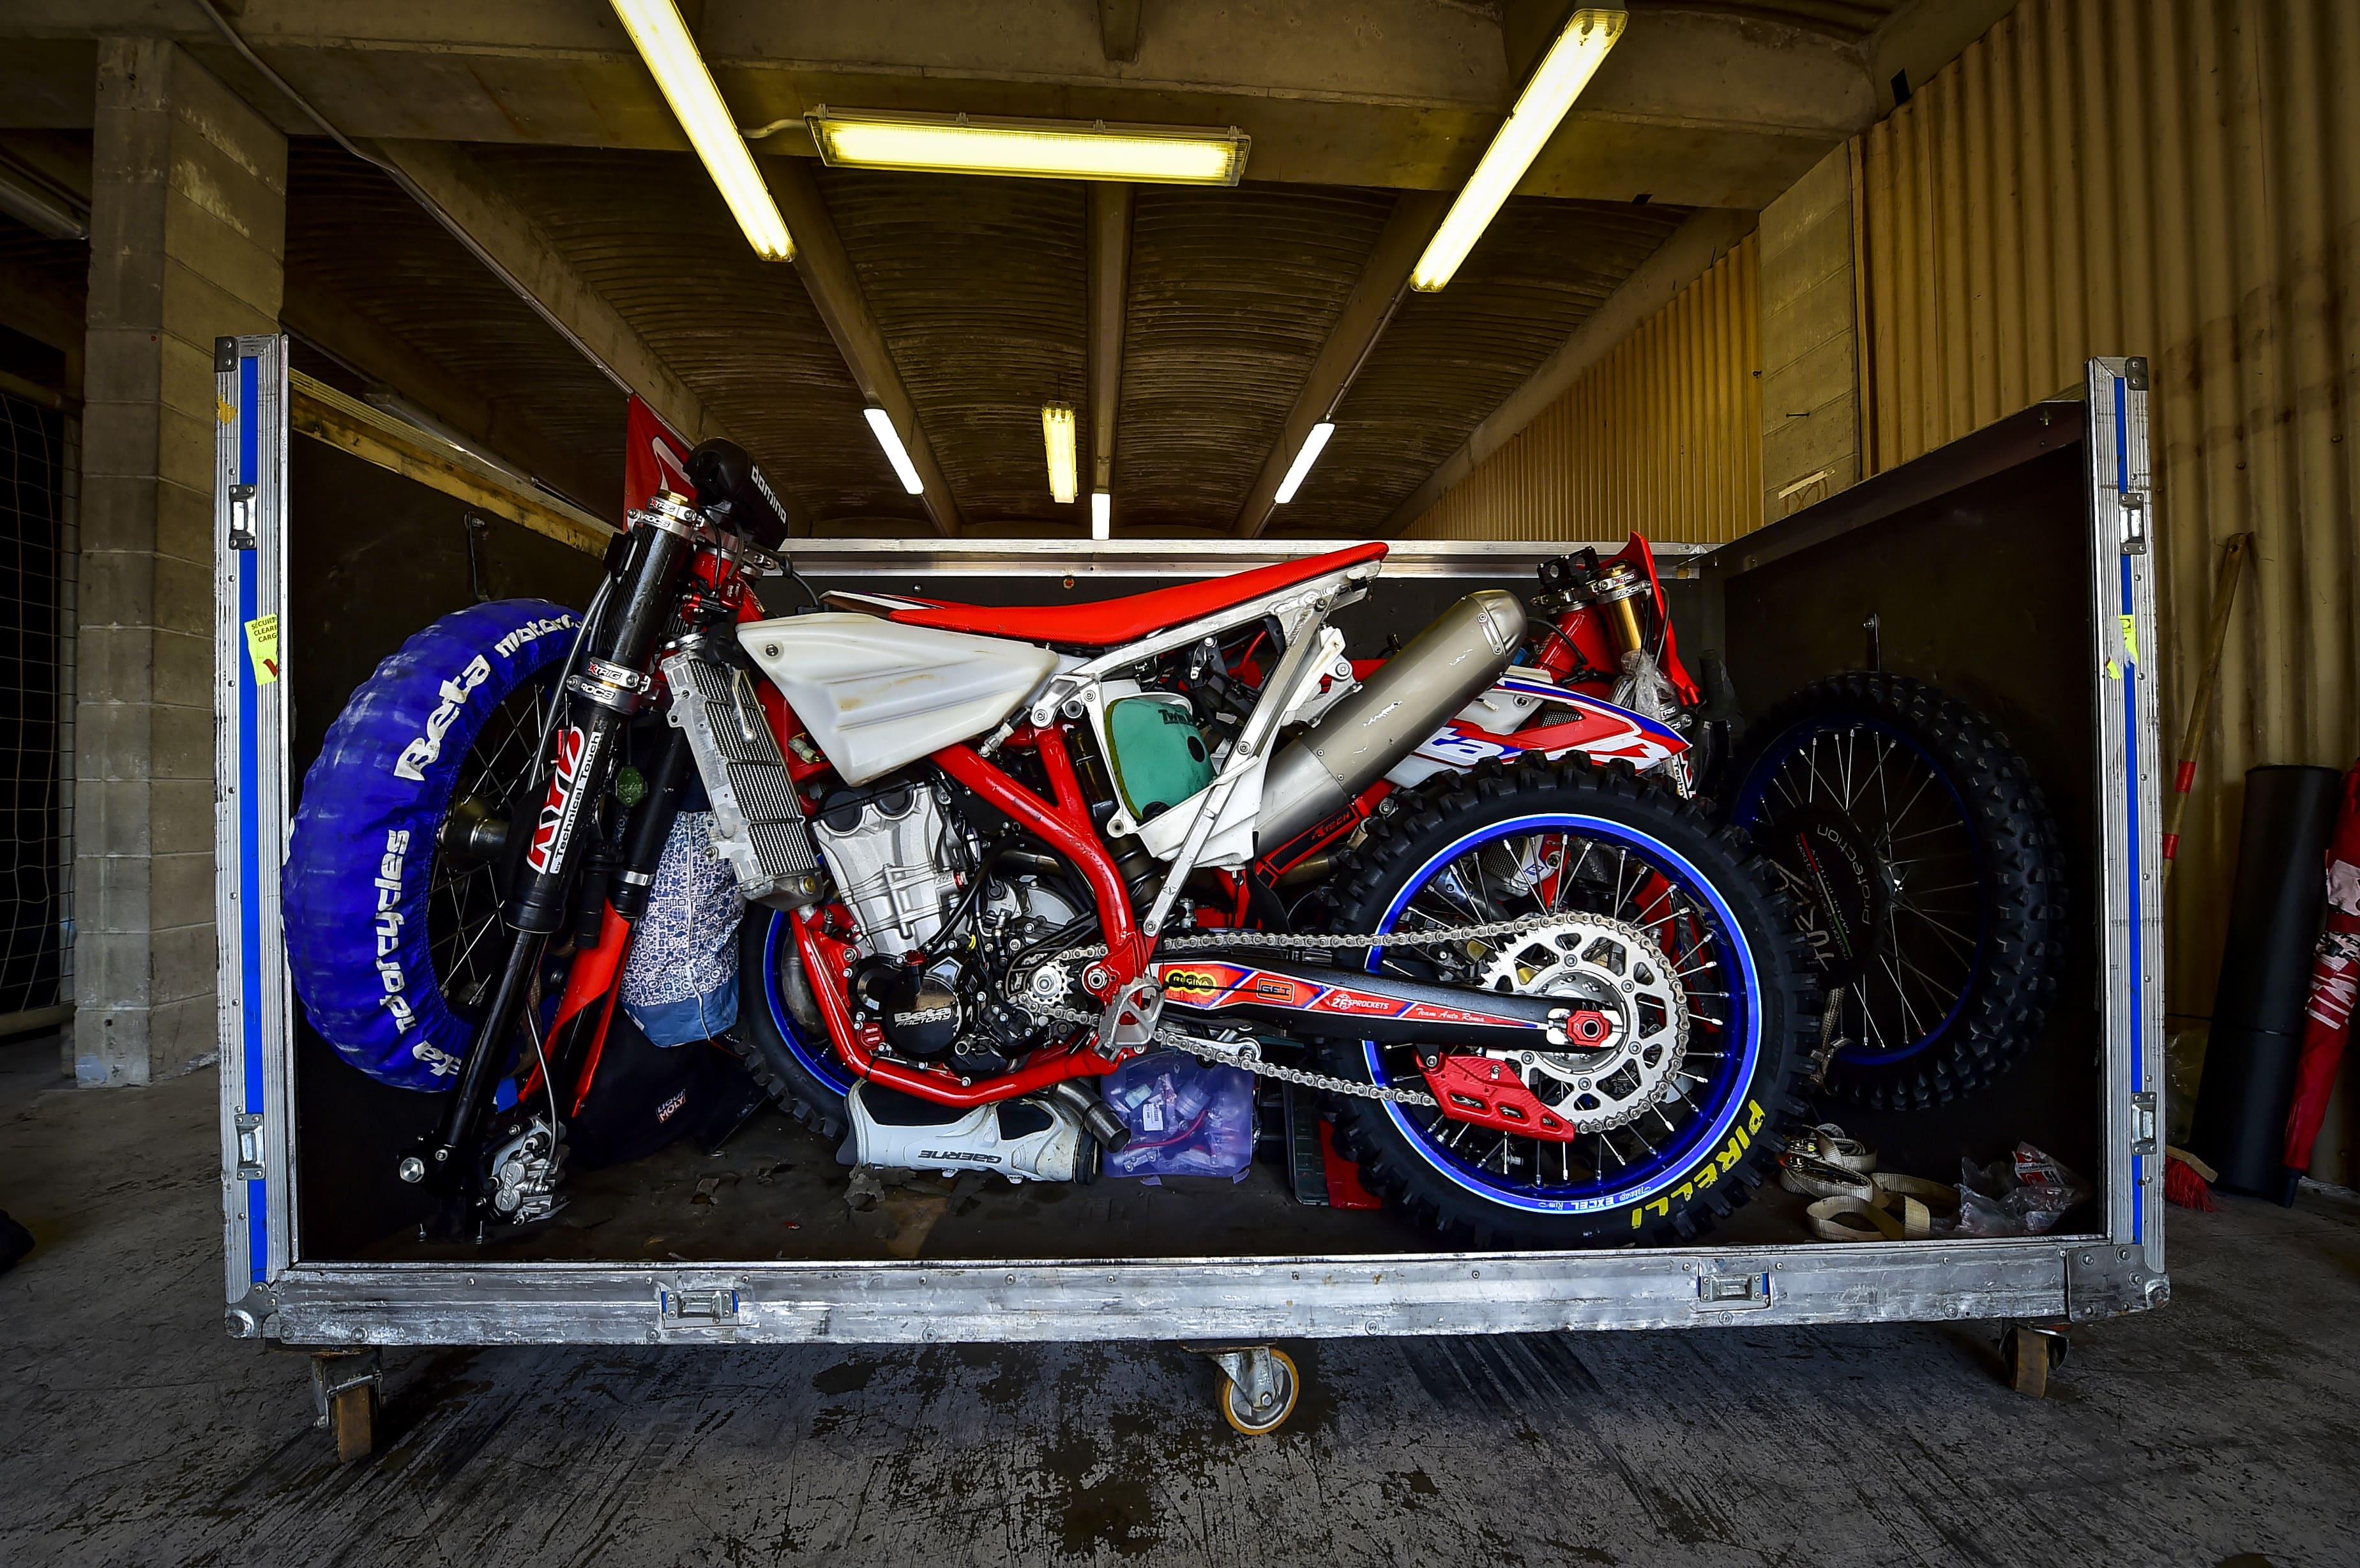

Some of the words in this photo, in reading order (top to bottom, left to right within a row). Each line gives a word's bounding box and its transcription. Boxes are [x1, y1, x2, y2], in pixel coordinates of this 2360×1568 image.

[752, 465, 787, 524] domino
[650, 498, 676, 512] XTRIG
[1617, 586, 1639, 598] ROCS
[258, 633, 277, 642] CARG
[588, 661, 623, 680] XTRIG
[580, 682, 616, 700] ROCS
[393, 654, 490, 781] Beta
[1660, 705, 1676, 719] TRIG
[555, 786, 584, 859] Technical
[579, 734, 600, 783] Touch
[1172, 976, 1209, 987] REGINA
[1348, 998, 1390, 1011] SPROCKETS
[894, 1007, 952, 1022] Beta
[895, 1014, 951, 1028] FACTORY
[1415, 1007, 1437, 1018] Team
[1438, 1011, 1459, 1020] Auto
[1461, 1013, 1485, 1023] Roma
[659, 1096, 683, 1122] MOLY
[1631, 1099, 1766, 1230] PIRELLI
[1541, 1201, 1564, 1211] Rim
[1571, 1196, 1615, 1210] EXCEL
